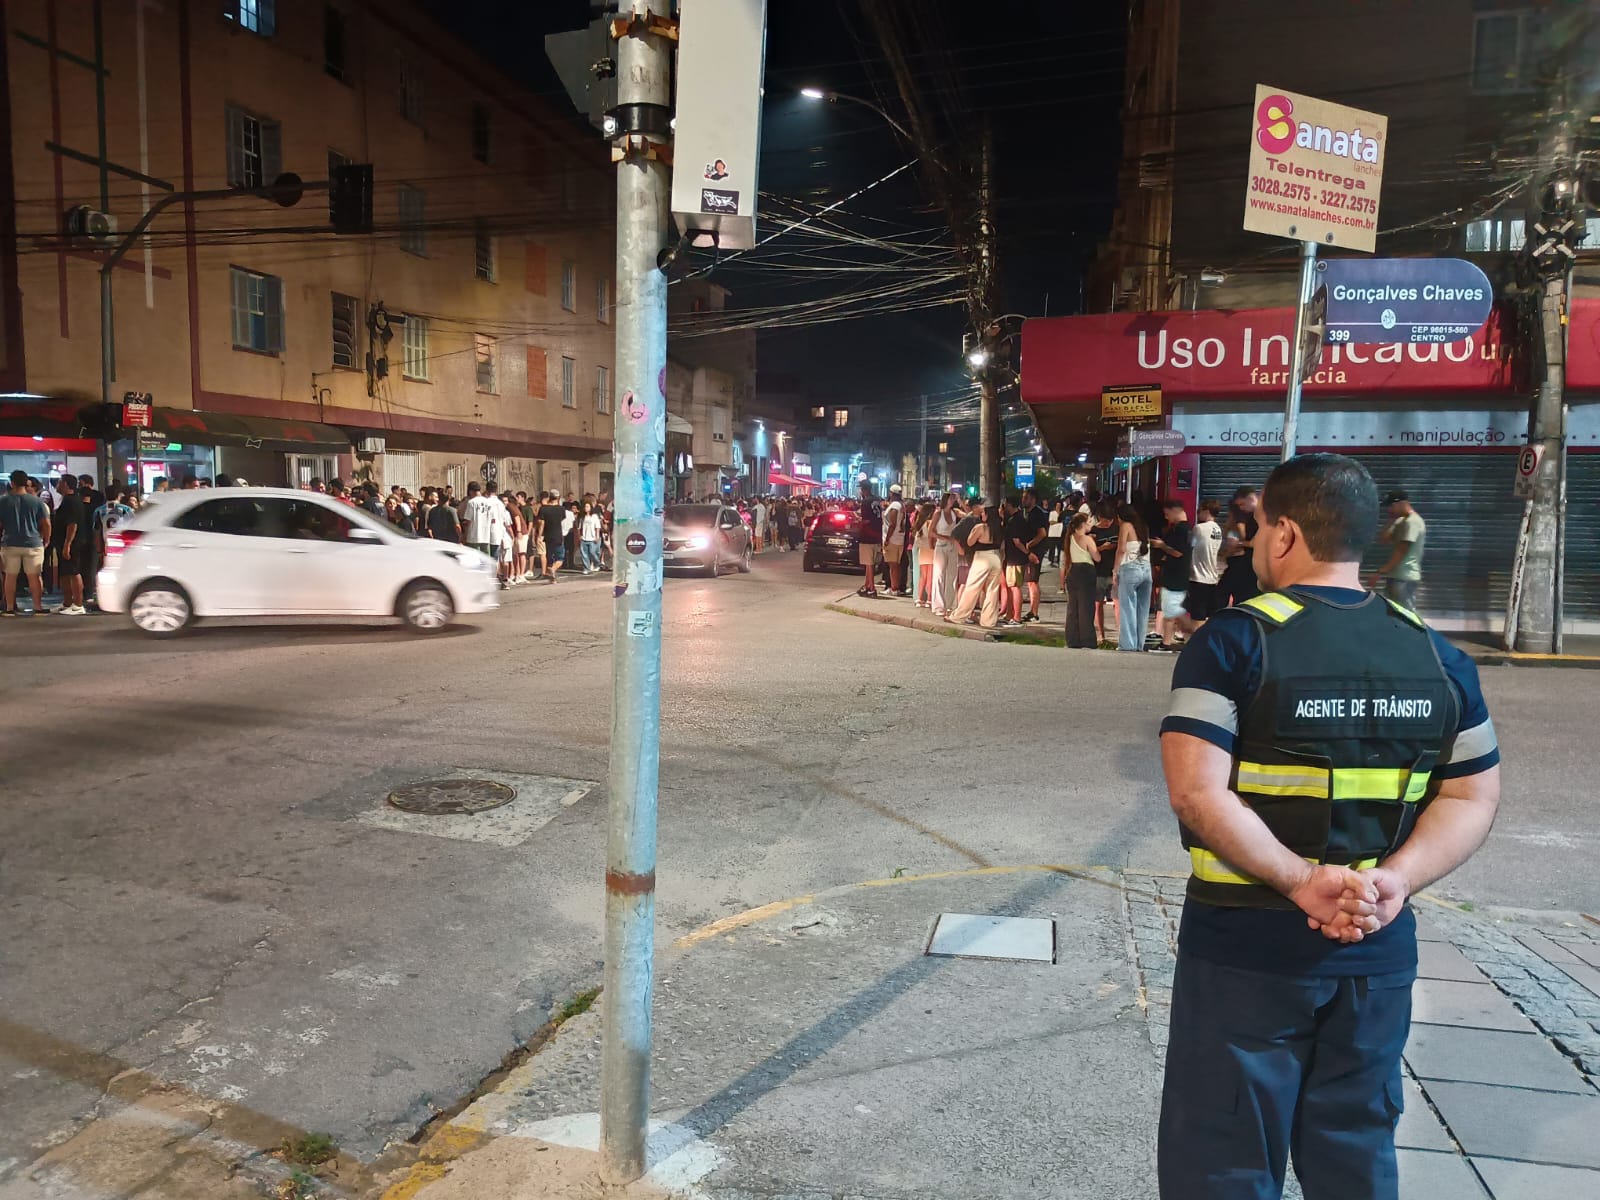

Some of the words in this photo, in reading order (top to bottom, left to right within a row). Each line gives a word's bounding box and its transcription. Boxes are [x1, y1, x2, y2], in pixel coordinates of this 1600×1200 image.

[1266, 157, 1366, 190] Telentrega
[1251, 176, 1311, 202] 3028.2575
[1320, 190, 1377, 215] 3227.2575
[1250, 198, 1376, 230] www.sanatalanches.com.br
[1333, 285, 1418, 304] Gonçalves
[1422, 285, 1483, 301] Chaves
[1329, 329, 1350, 341] 399
[1411, 326, 1429, 334] CEP
[1410, 334, 1446, 342] CENTRO
[1137, 329, 1226, 369] Uso
[1242, 327, 1474, 367] Inicado
[1110, 394, 1152, 405] MOTEL
[1400, 427, 1505, 446] manipulação
[1523, 453, 1532, 470] E
[1295, 699, 1345, 718] AGENTE
[1351, 699, 1366, 717] DE
[1372, 695, 1432, 718] TRÂNSITO
